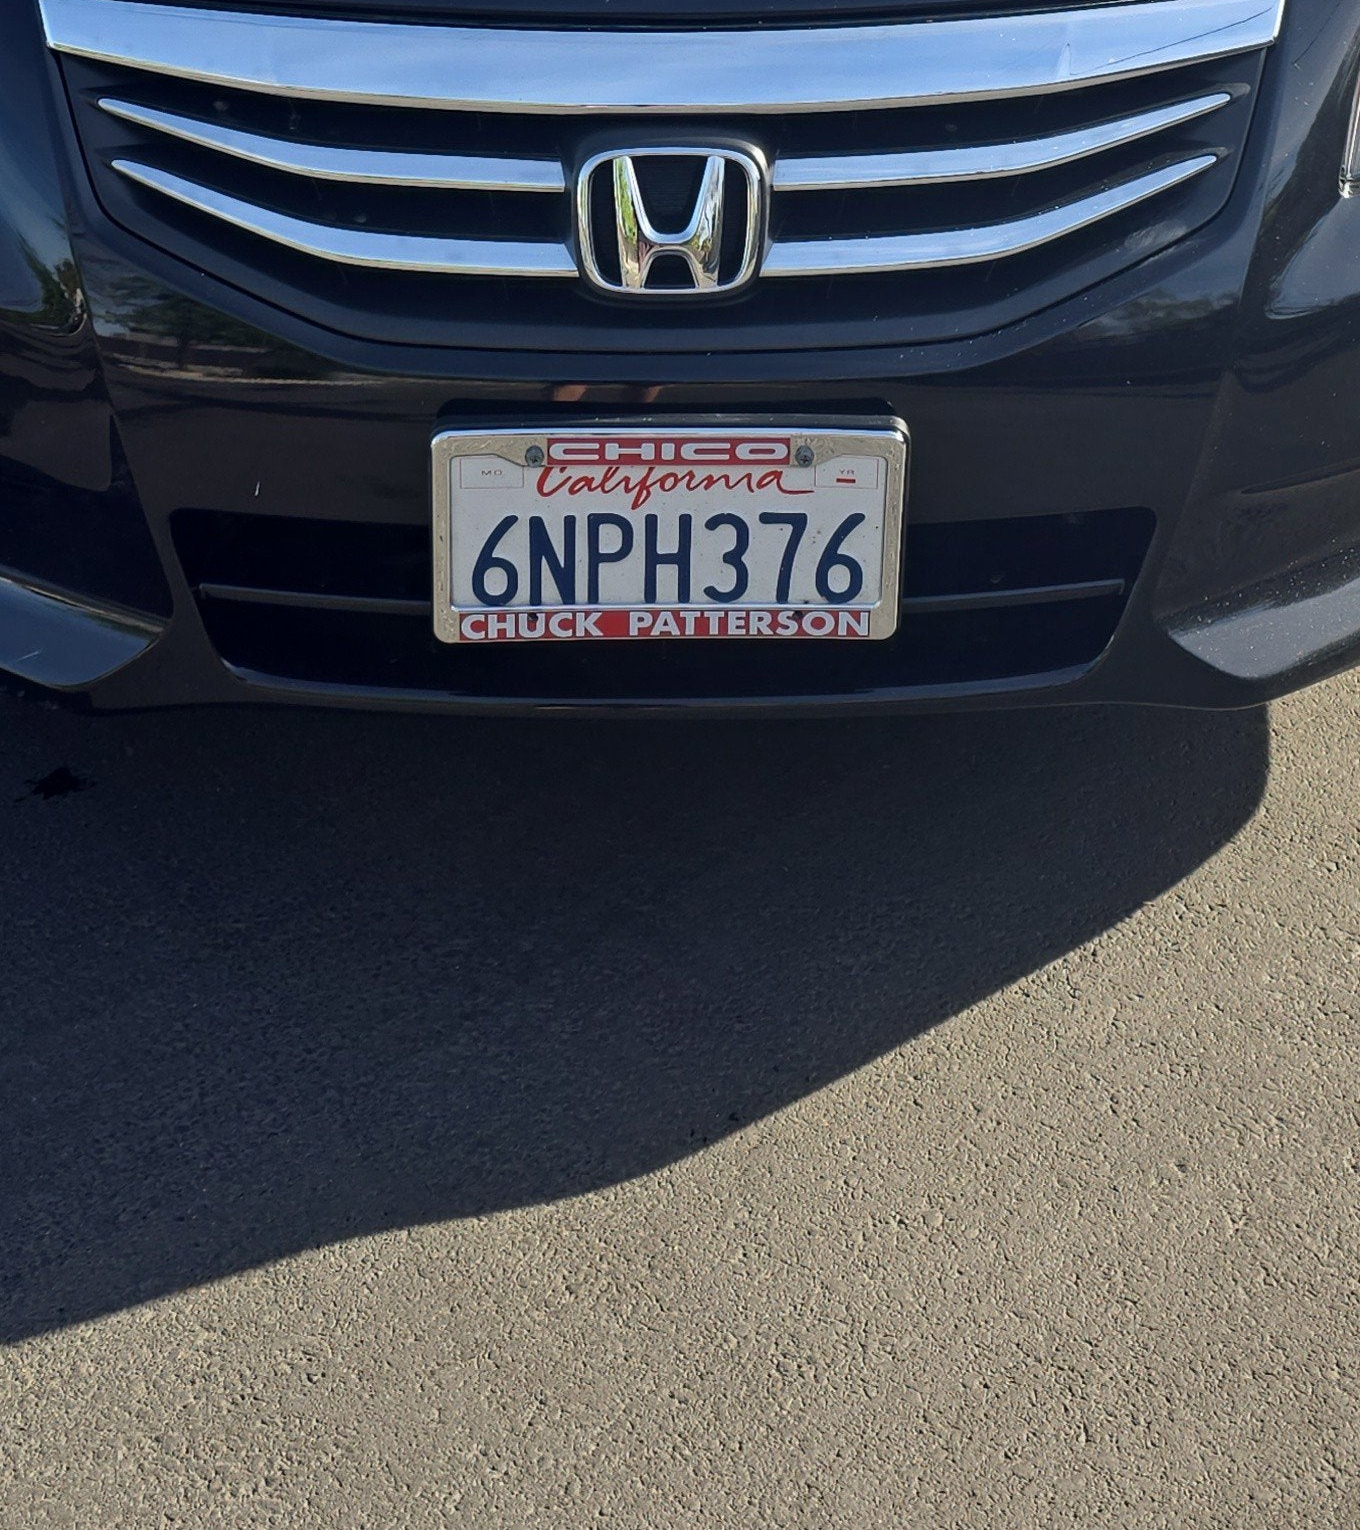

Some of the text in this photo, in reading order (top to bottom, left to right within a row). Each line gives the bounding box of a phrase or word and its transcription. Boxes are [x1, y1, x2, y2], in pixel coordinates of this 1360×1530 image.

[548, 442, 789, 461] CHICO
[481, 469, 503, 477] MO
[536, 466, 815, 511] California
[471, 512, 867, 606] 6NPH376
[460, 610, 870, 640] CHUCK PATTERSON
